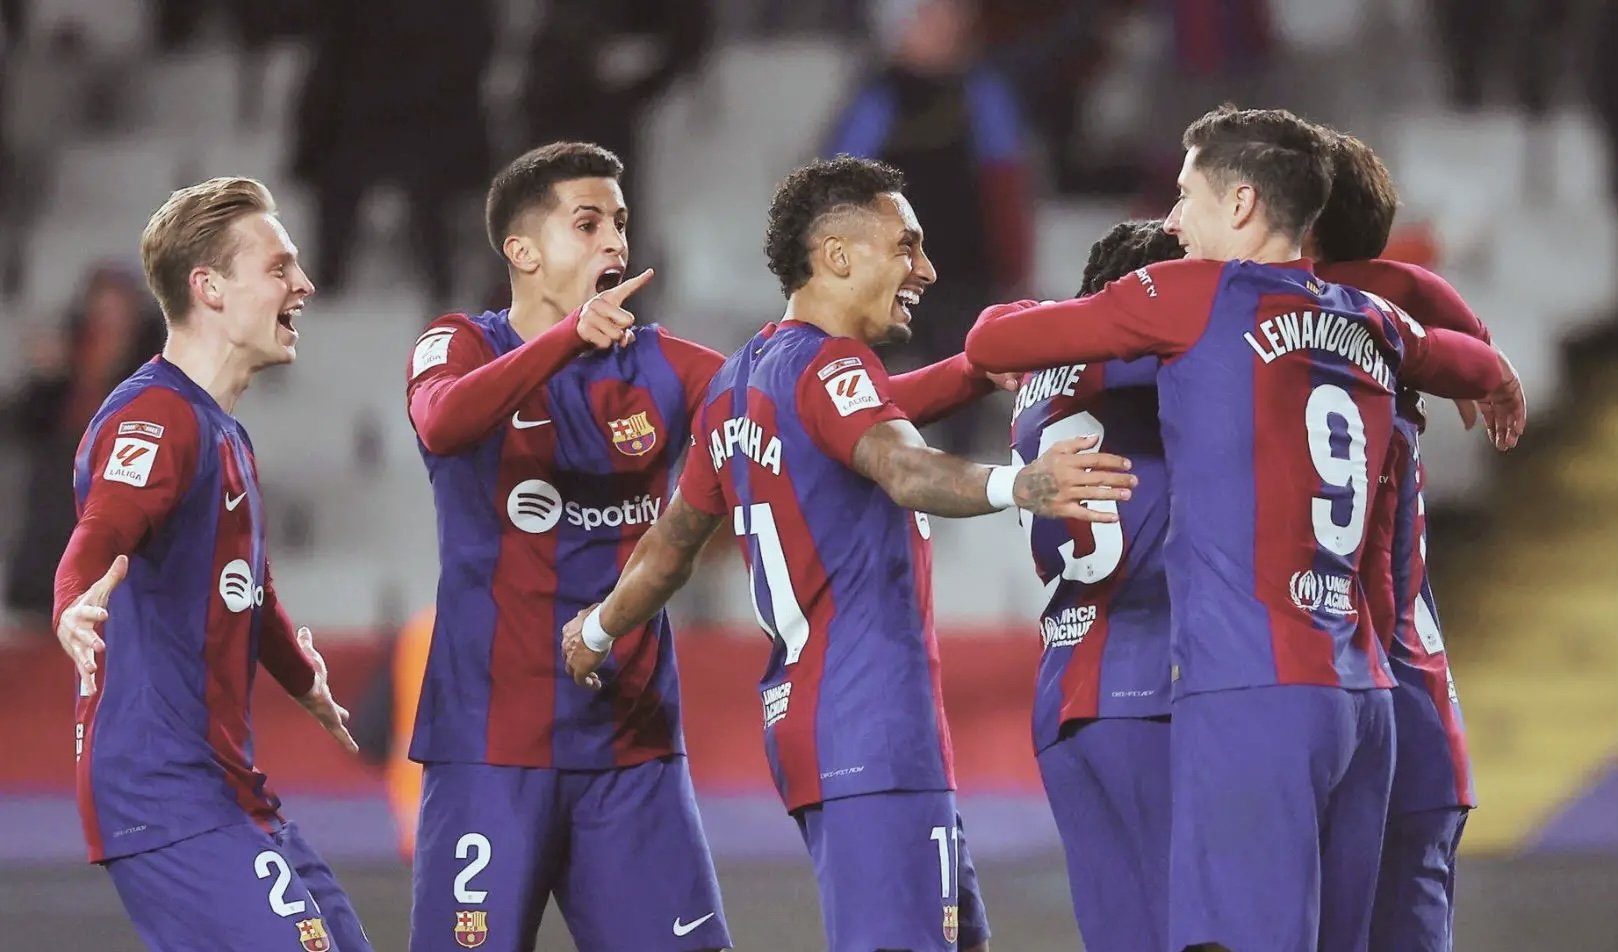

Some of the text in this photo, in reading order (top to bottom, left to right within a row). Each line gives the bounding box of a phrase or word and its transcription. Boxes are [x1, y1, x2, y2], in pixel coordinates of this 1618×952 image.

[1243, 310, 1390, 389] LEWANDOWSKI
[842, 395, 875, 411] LALIGA
[1010, 363, 1087, 427] OUNDE
[109, 469, 143, 481] LALIGA
[1012, 410, 1124, 585] 3
[1305, 384, 1369, 556] 9
[565, 495, 661, 530] Spotify
[254, 850, 320, 917] 2
[453, 832, 492, 904] 2
